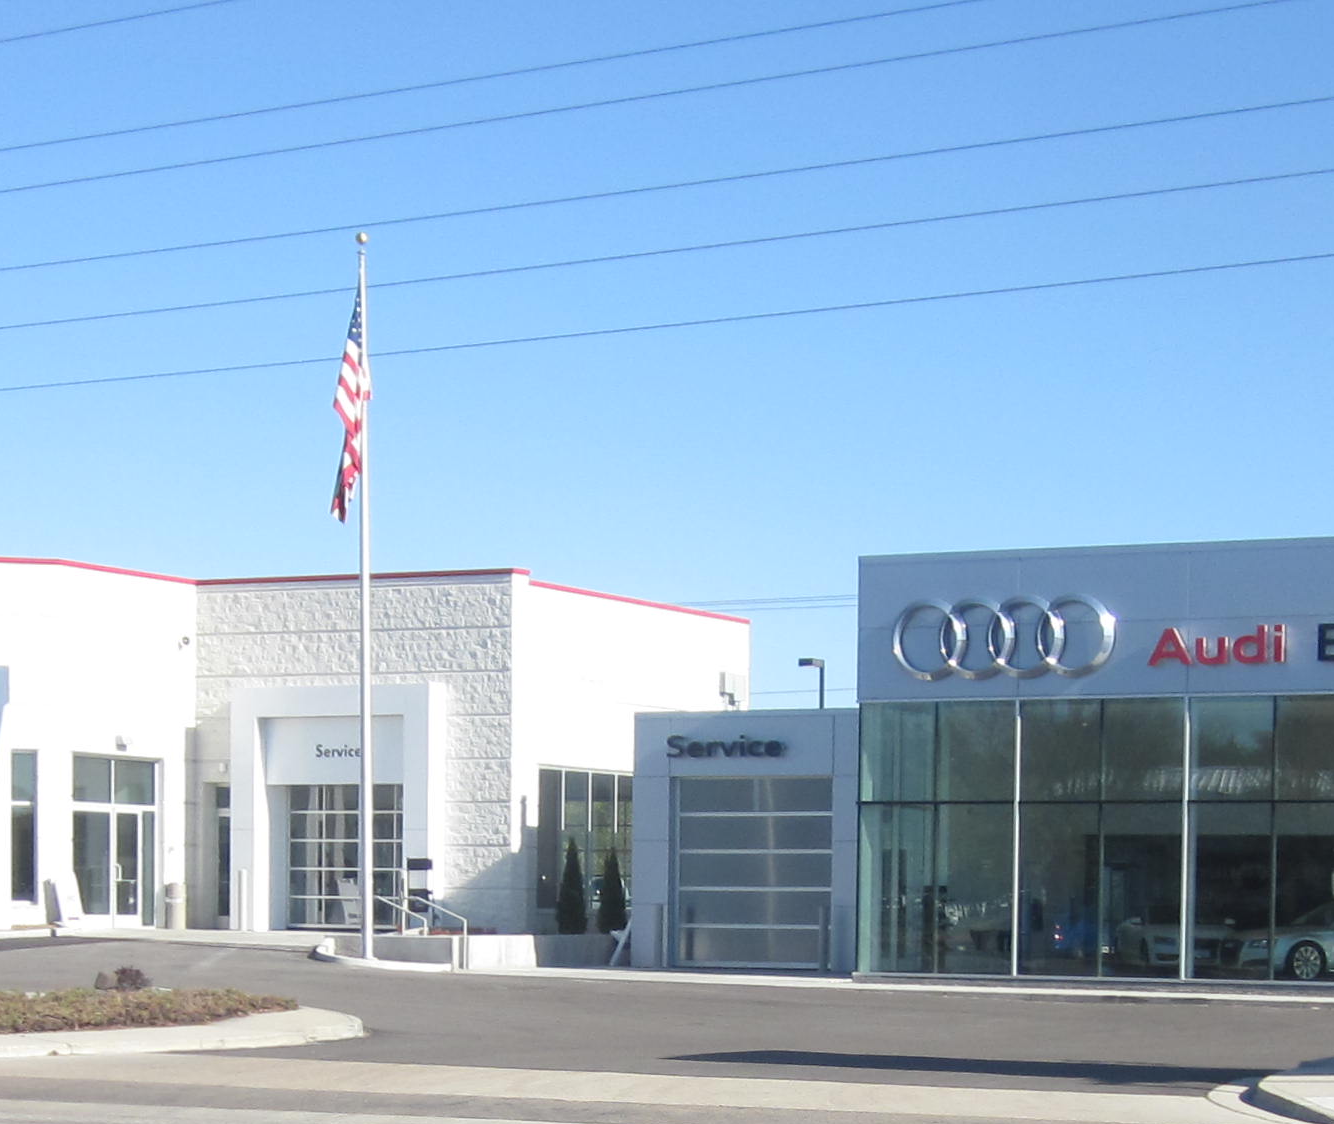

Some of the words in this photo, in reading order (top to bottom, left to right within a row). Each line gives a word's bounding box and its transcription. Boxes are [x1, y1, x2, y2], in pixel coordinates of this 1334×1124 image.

[1147, 622, 1287, 667] Audi
[315, 744, 362, 757] Service
[667, 734, 785, 758] Service
